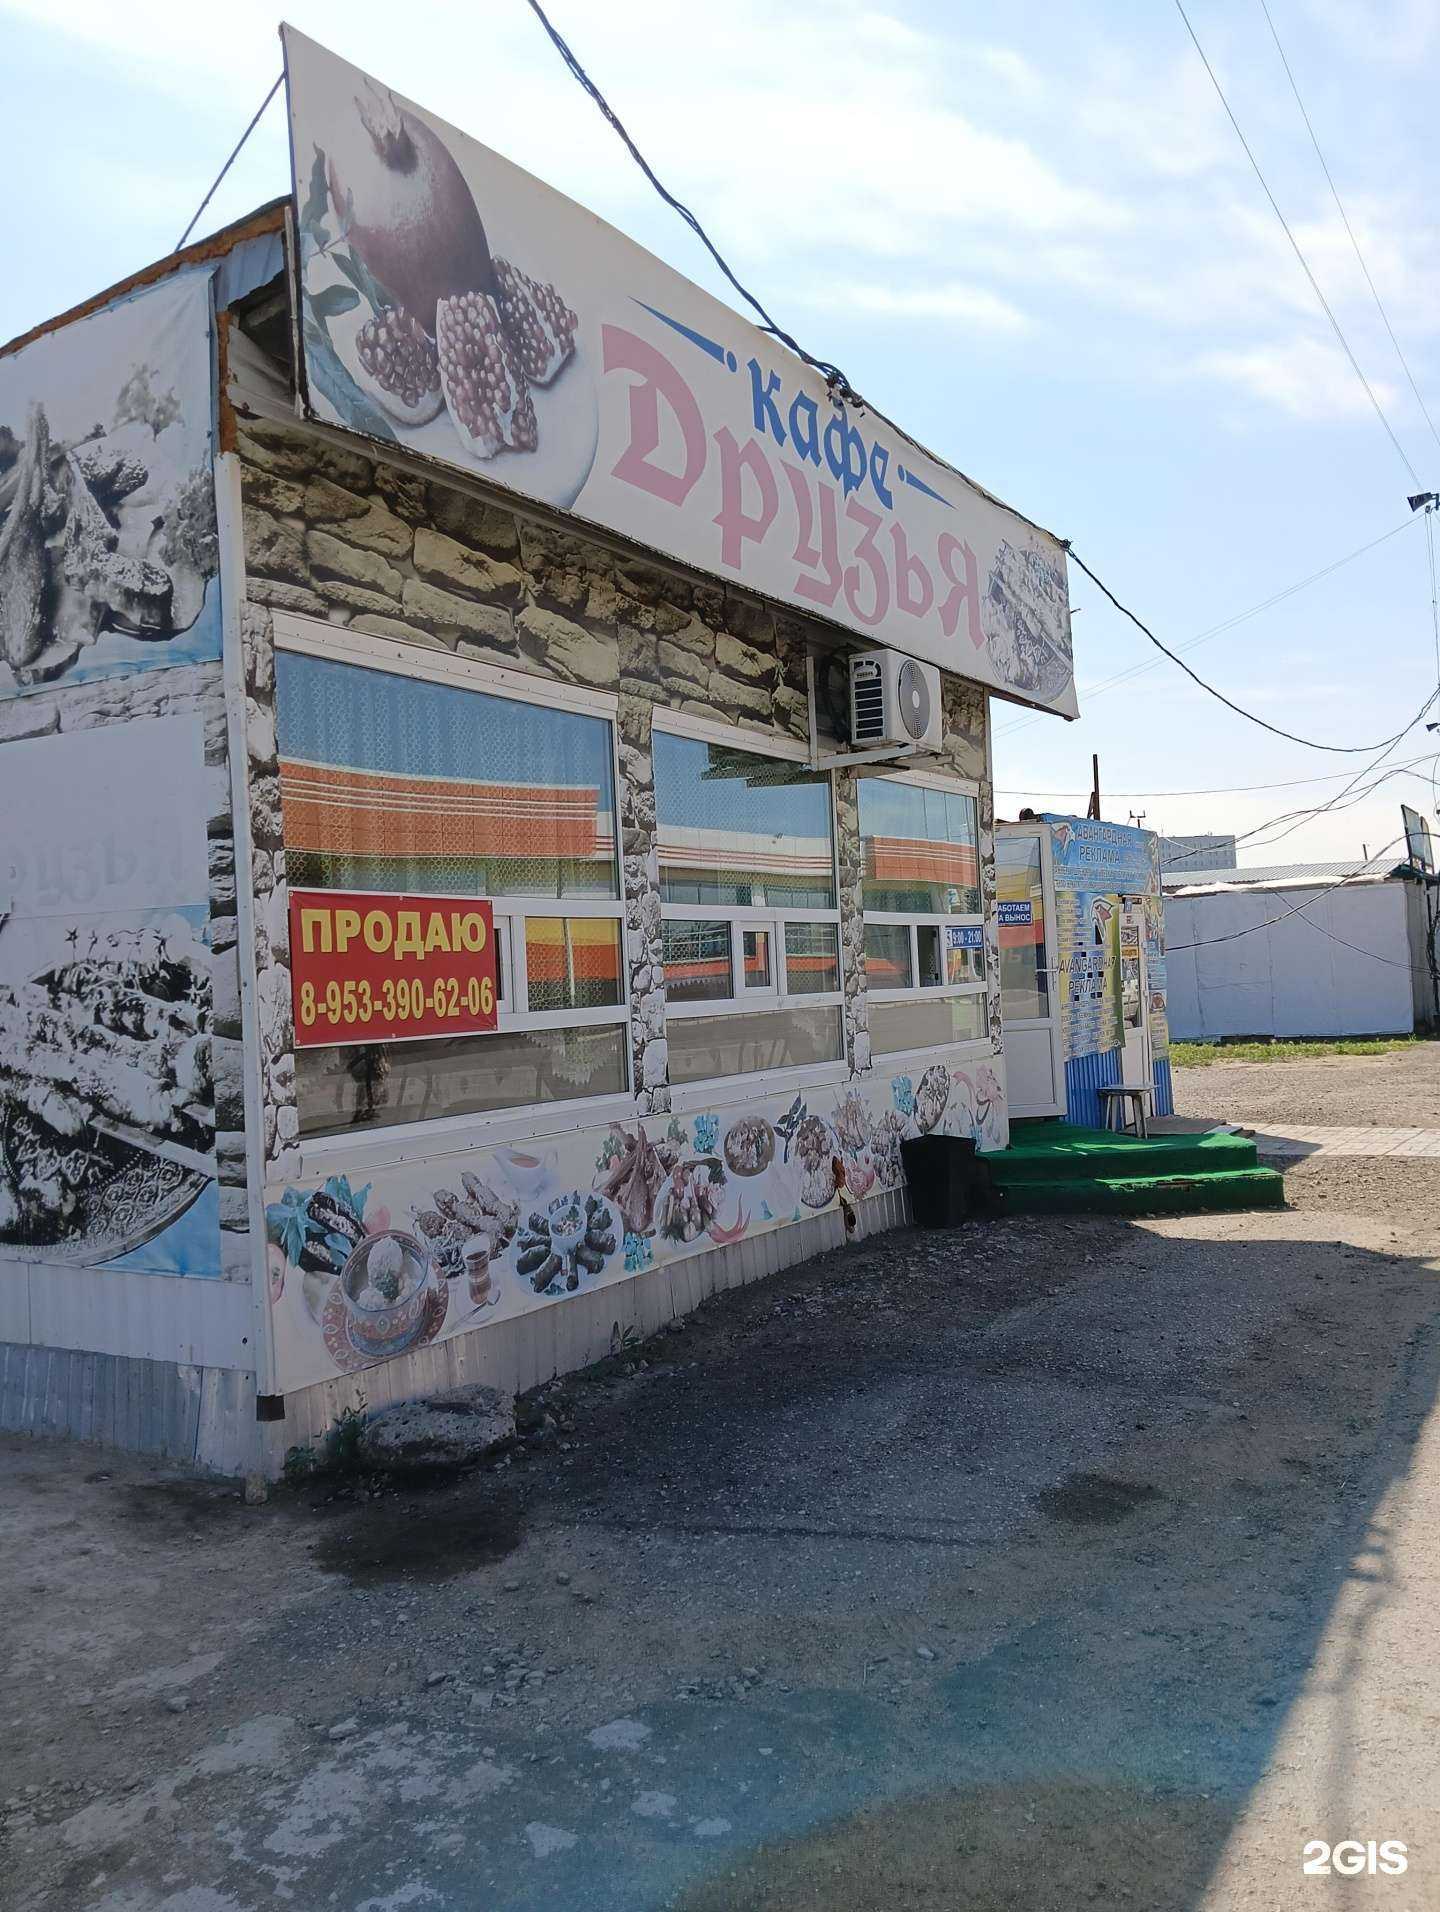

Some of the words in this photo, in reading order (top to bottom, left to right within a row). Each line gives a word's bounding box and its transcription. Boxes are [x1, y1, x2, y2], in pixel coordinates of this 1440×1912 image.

[747, 358, 893, 510] кафе
[602, 323, 985, 650] Друзья
[1077, 826, 1133, 848] АВАНГАРДНАЯ
[1079, 845, 1120, 864] РЕКЛАМА
[998, 904, 1030, 912] АБОТАЕМ
[1005, 913, 1031, 922] ВЫНОС
[301, 908, 487, 960] ПРОДАЮ
[301, 976, 494, 1026] 8-953-390-62-06
